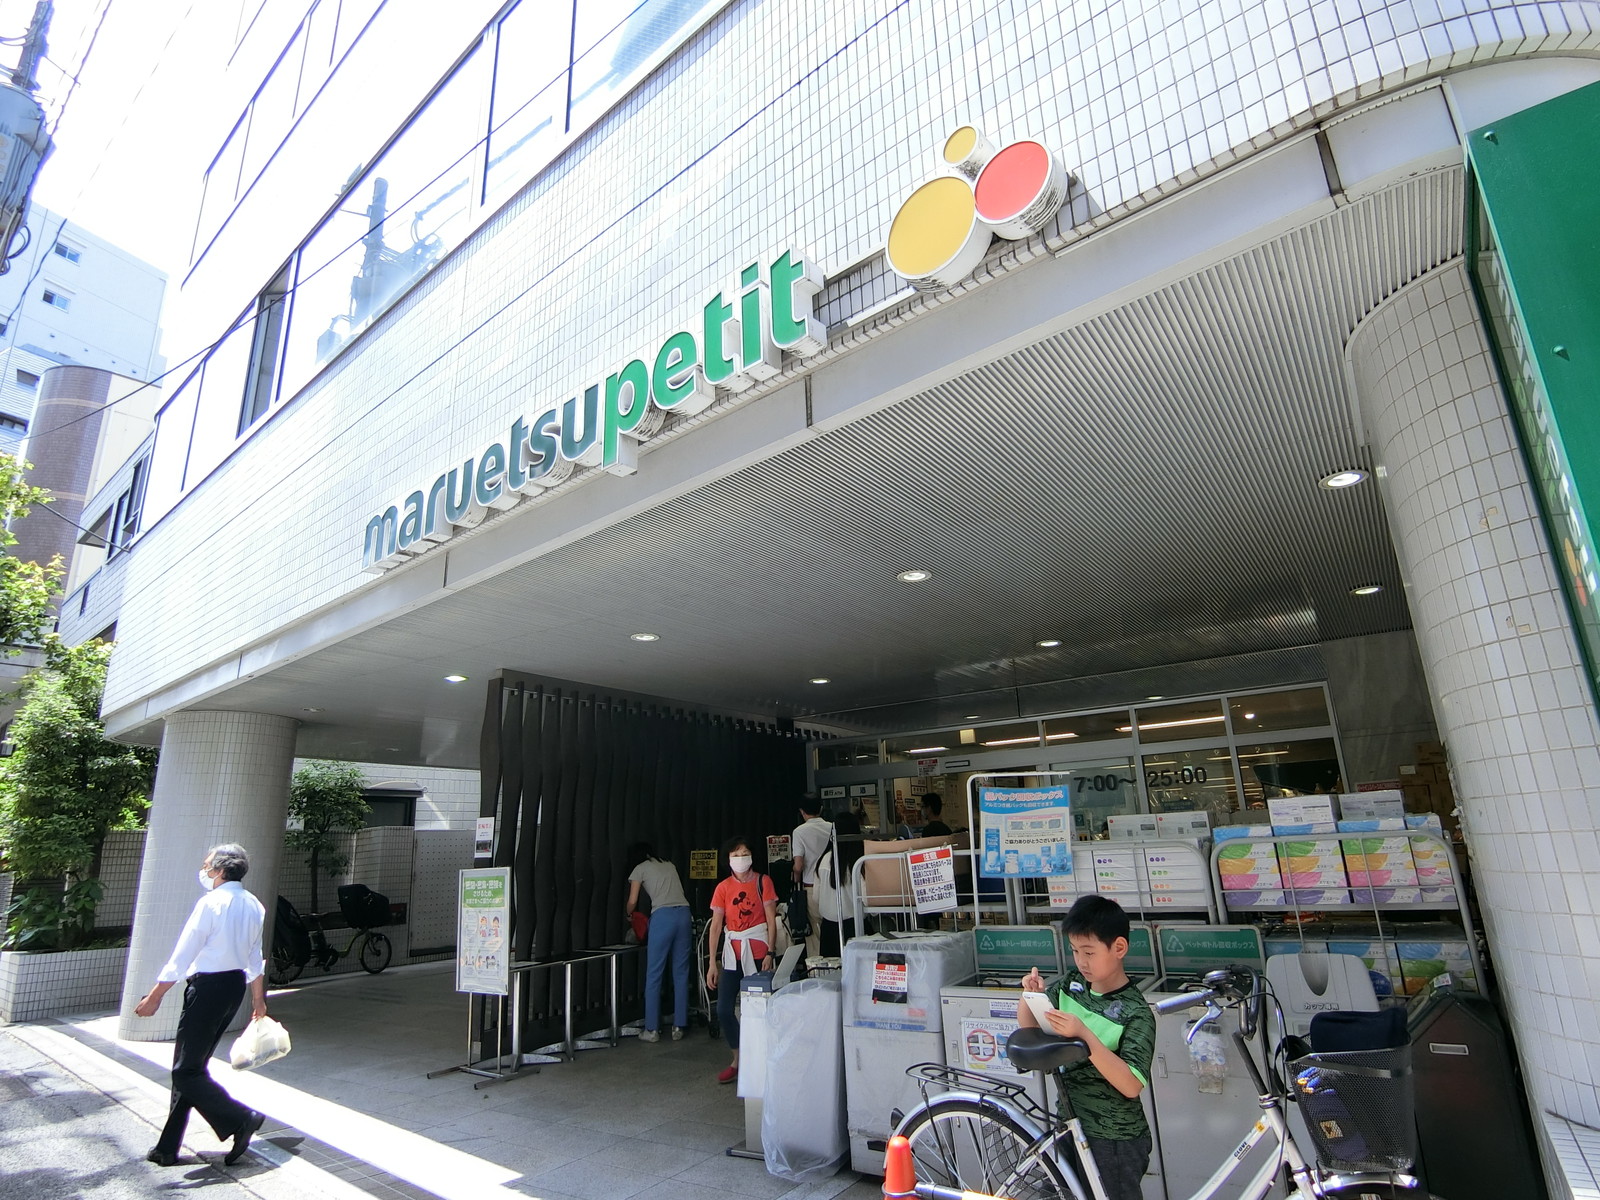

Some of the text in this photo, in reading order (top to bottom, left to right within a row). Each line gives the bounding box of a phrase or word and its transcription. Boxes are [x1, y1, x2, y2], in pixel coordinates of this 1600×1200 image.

[1147, 767, 1208, 788] 25:00
[922, 851, 938, 861] 注意
[1185, 941, 1256, 950] ペットボトル回収ボックス
[1304, 1002, 1340, 1011] カップ専用
